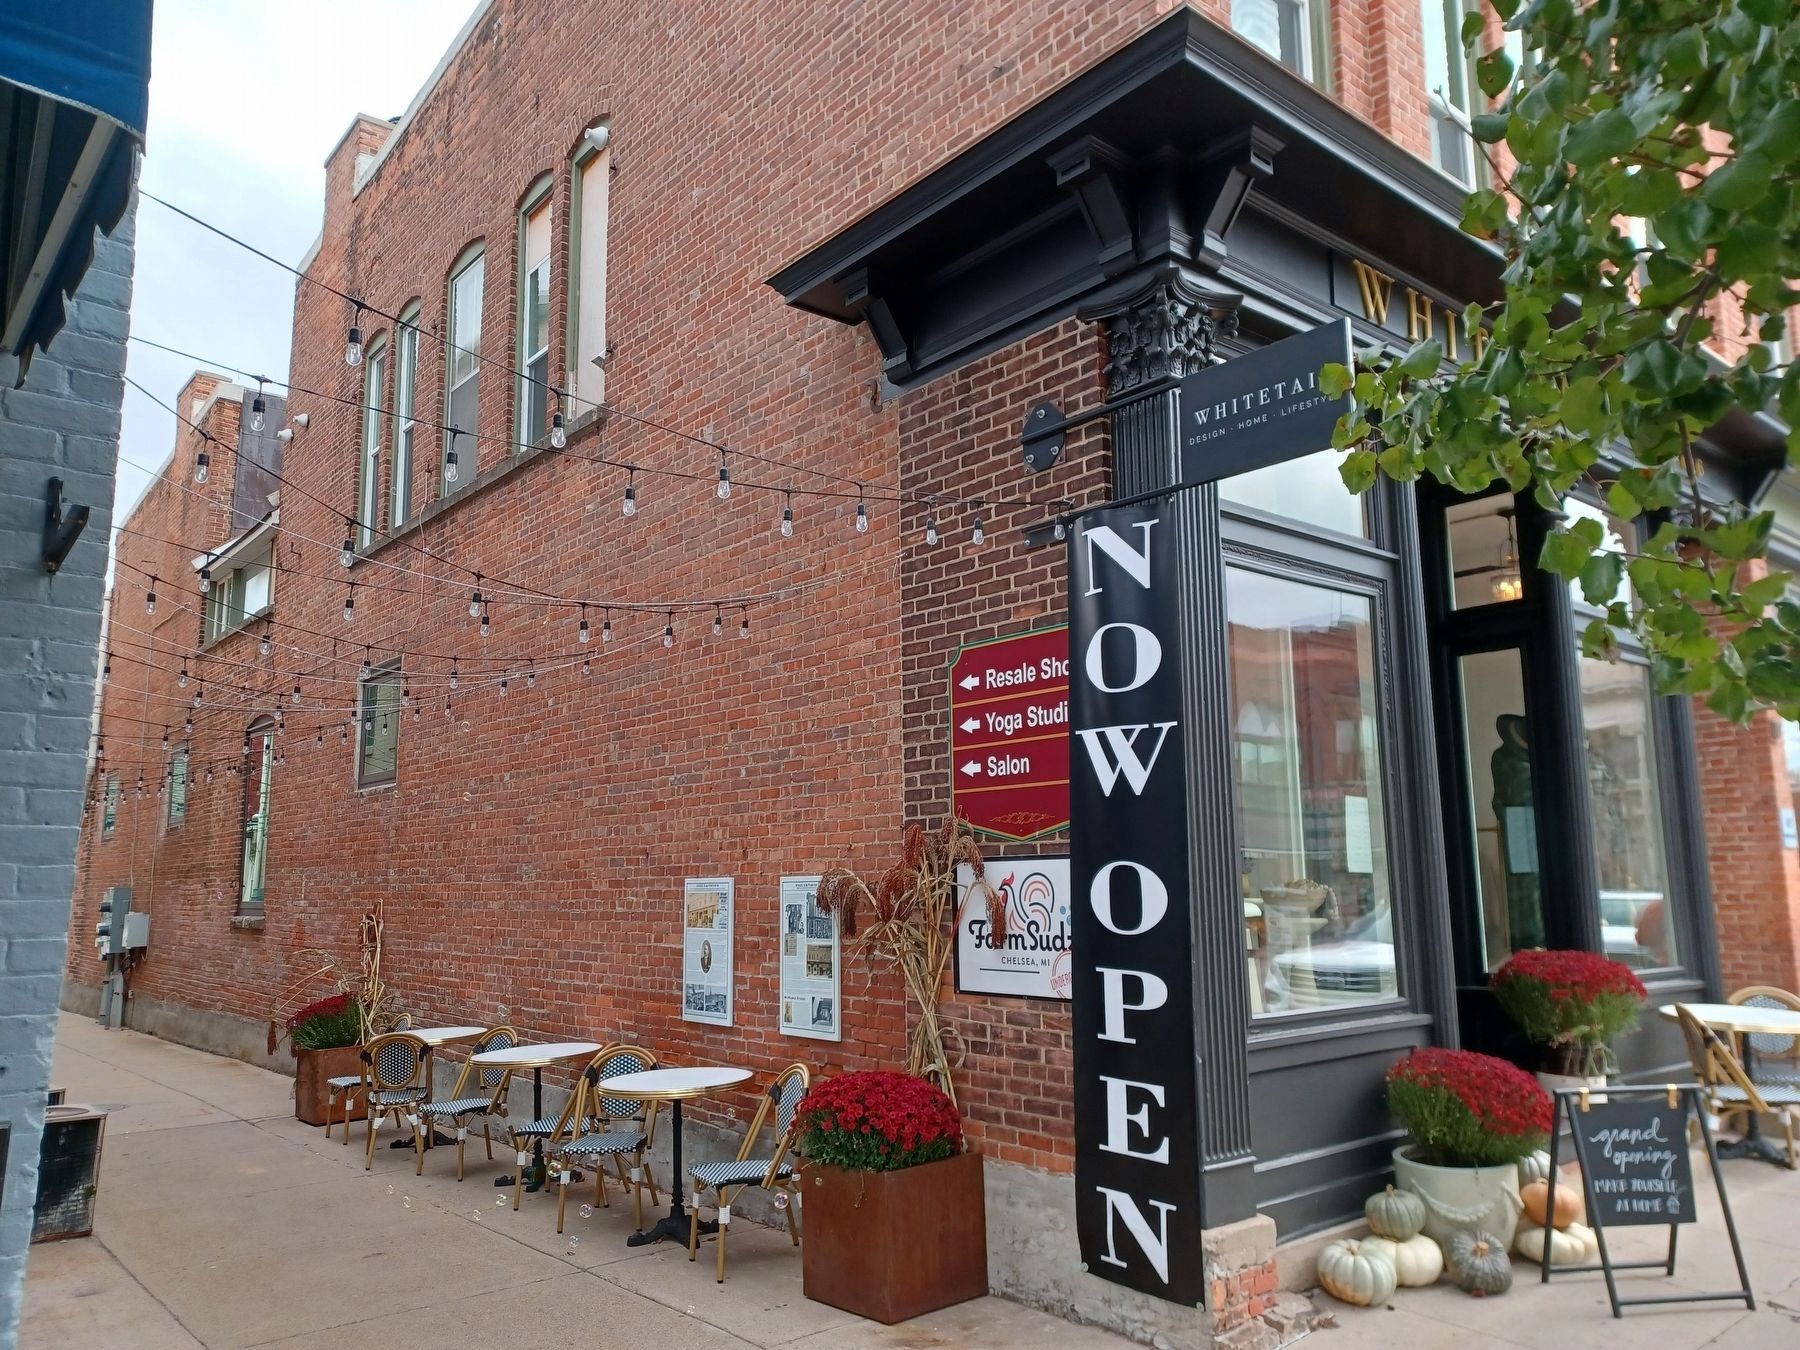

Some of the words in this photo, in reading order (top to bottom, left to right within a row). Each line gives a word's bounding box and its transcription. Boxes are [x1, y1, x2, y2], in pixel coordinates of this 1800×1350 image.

[1194, 371, 1316, 425] WHITETAI
[1189, 427, 1226, 446] DESIGN
[1238, 413, 1268, 429] HOME
[1281, 394, 1335, 417] LIFESTYL
[985, 662, 1037, 690] Resale
[1040, 656, 1070, 680] Sho
[1075, 518, 1179, 798] NOW
[985, 710, 1023, 736] Yoga
[1026, 700, 1069, 727] Studi
[986, 754, 1030, 777] Salon
[1001, 956, 1039, 968] CHELSEA,
[1040, 958, 1051, 967] MI
[1089, 860, 1179, 1286] OPEN
[1588, 1116, 1669, 1159] grand
[1612, 1145, 1678, 1180] opening
